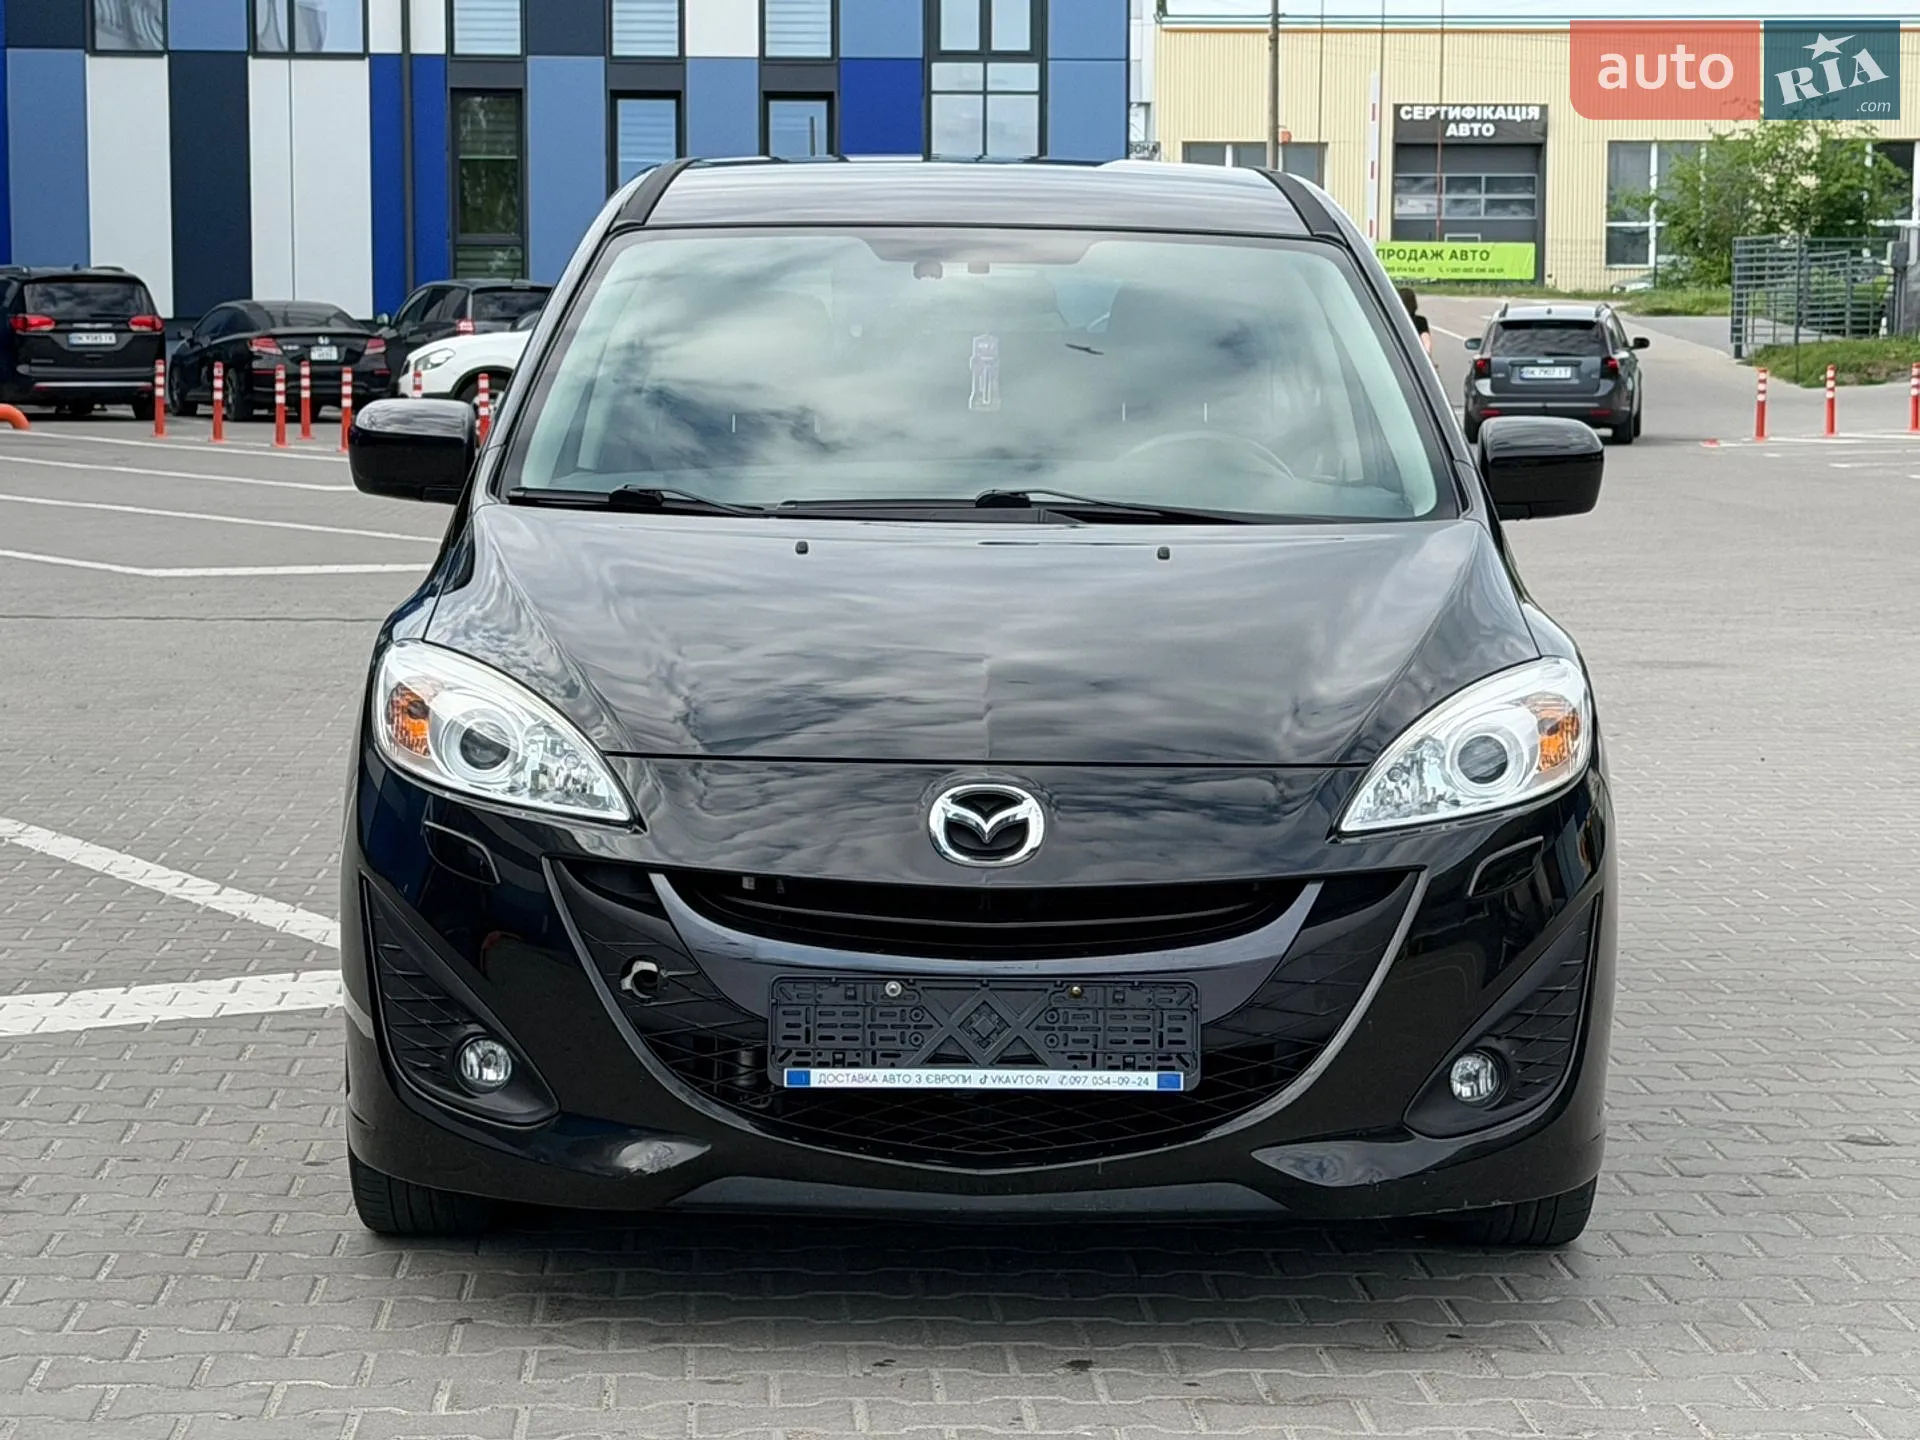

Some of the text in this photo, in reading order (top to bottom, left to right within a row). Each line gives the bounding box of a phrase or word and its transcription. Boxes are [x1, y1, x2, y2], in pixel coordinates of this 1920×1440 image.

[1399, 105, 1541, 122] СЕРТИФІКАЦІЯ
[1445, 123, 1496, 137] АВТО
[1377, 249, 1490, 262] ПРОДАЖ АВТО
[818, 1073, 878, 1084] ДОСТАВКА
[881, 1073, 912, 1084] АВТО
[925, 1073, 972, 1085] ЄВРОПИ
